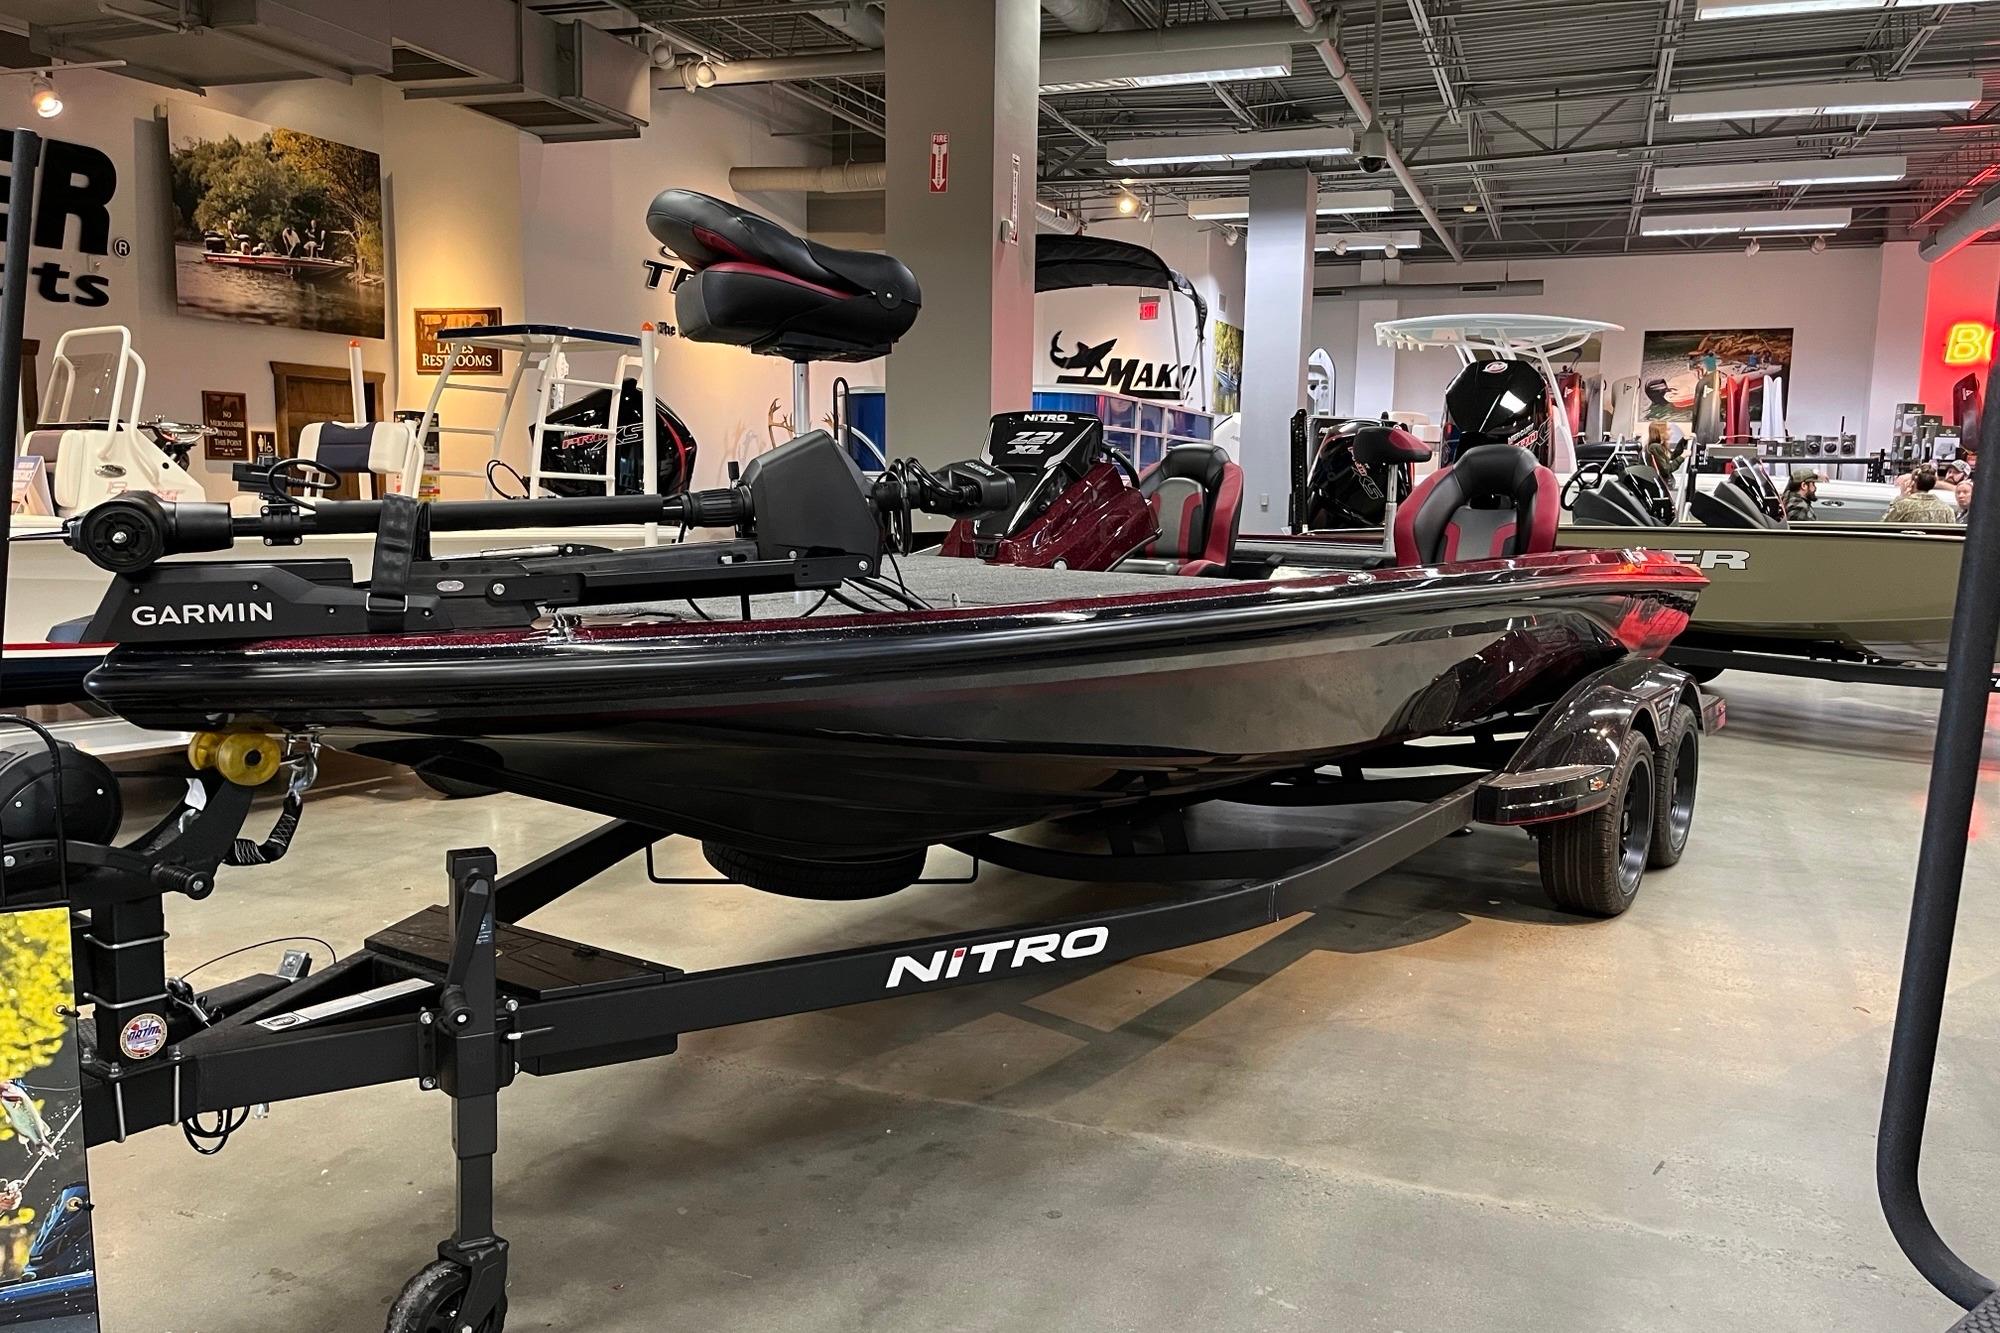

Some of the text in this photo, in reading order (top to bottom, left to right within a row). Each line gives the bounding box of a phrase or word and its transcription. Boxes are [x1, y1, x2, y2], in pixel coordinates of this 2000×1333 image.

[933, 134, 948, 143] FIRE
[1944, 323, 1992, 364] B
[422, 353, 493, 367] RESTOOMS
[1023, 413, 1068, 423] NITRO
[1007, 431, 1064, 445] Z21
[1006, 445, 1045, 455] XL
[131, 601, 273, 627] GARMIN
[885, 926, 1110, 989] NITRO
